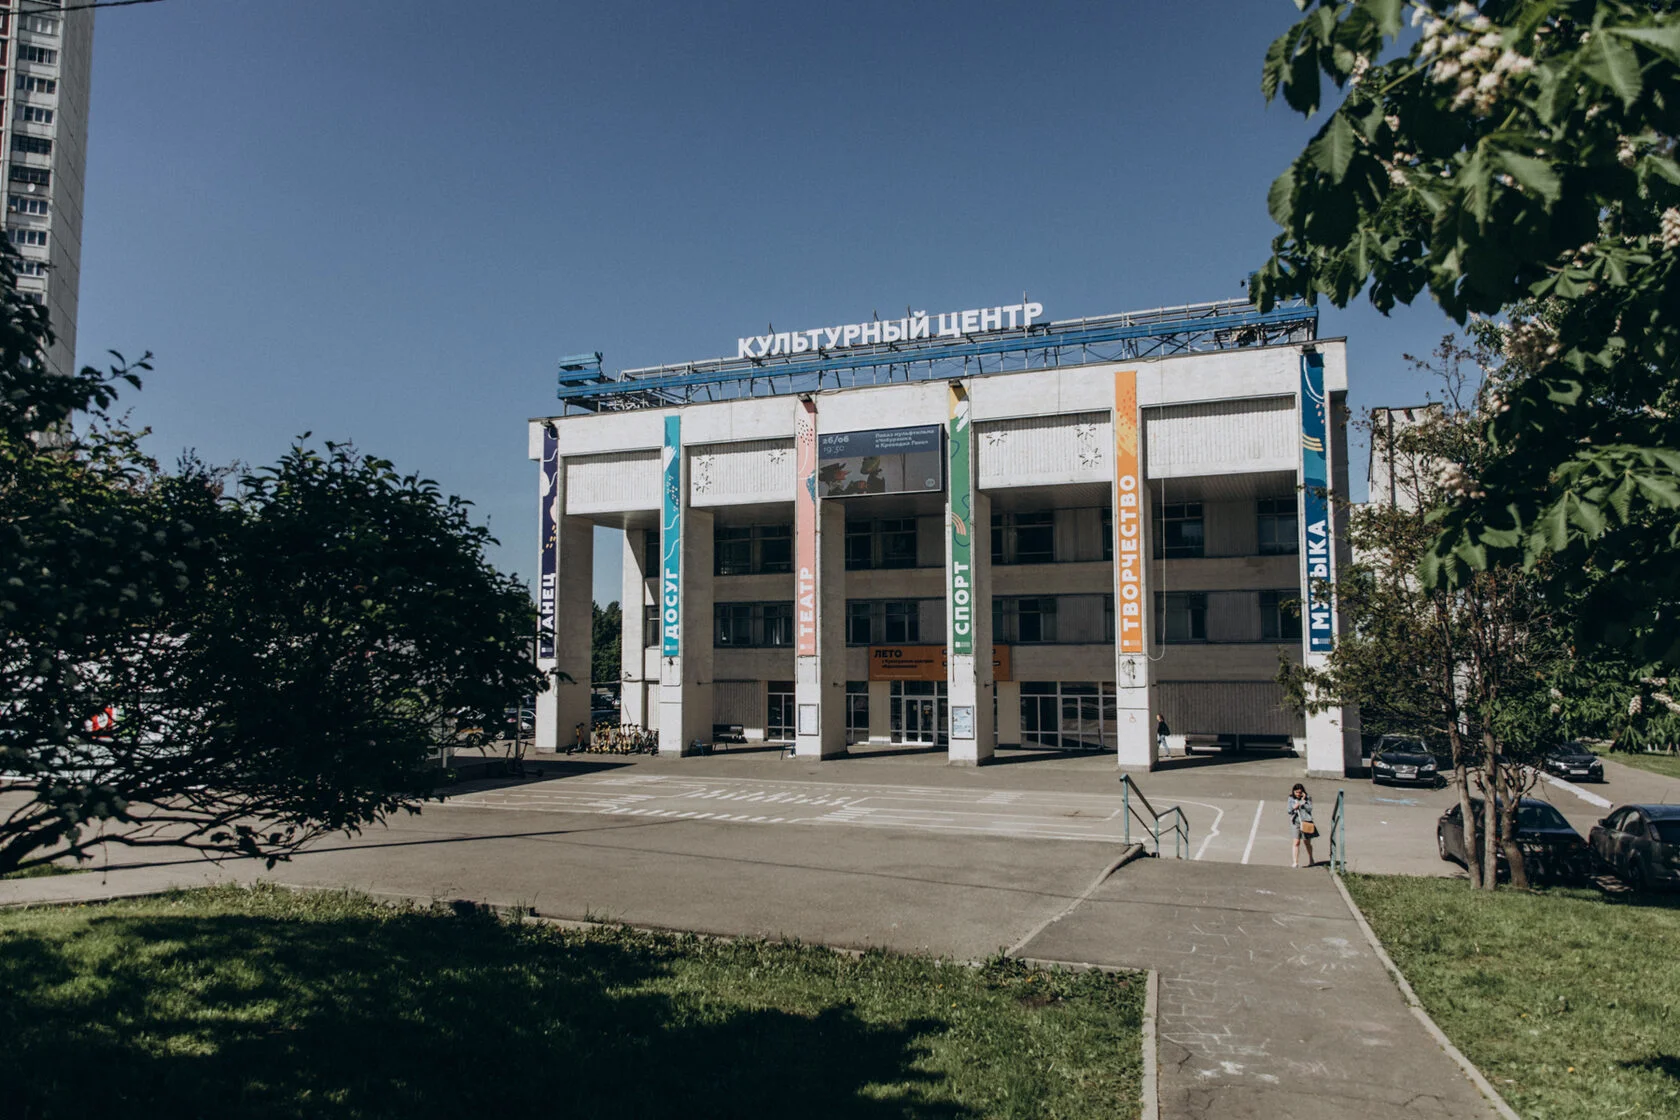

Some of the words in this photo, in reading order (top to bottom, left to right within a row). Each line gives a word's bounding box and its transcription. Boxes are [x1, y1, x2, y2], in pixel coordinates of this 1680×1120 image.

[737, 310, 930, 358] КУЛЬТУРНЫЙ
[938, 302, 1043, 338] ЦЕНТР
[822, 435, 849, 445] 26/06
[1119, 474, 1140, 632] ТВОРЧЕСТВО
[664, 568, 680, 640] ДОСУГ
[800, 567, 813, 637] ТЕАТР
[954, 561, 970, 635] СПОРТ
[873, 649, 903, 658] ЛЕТО
